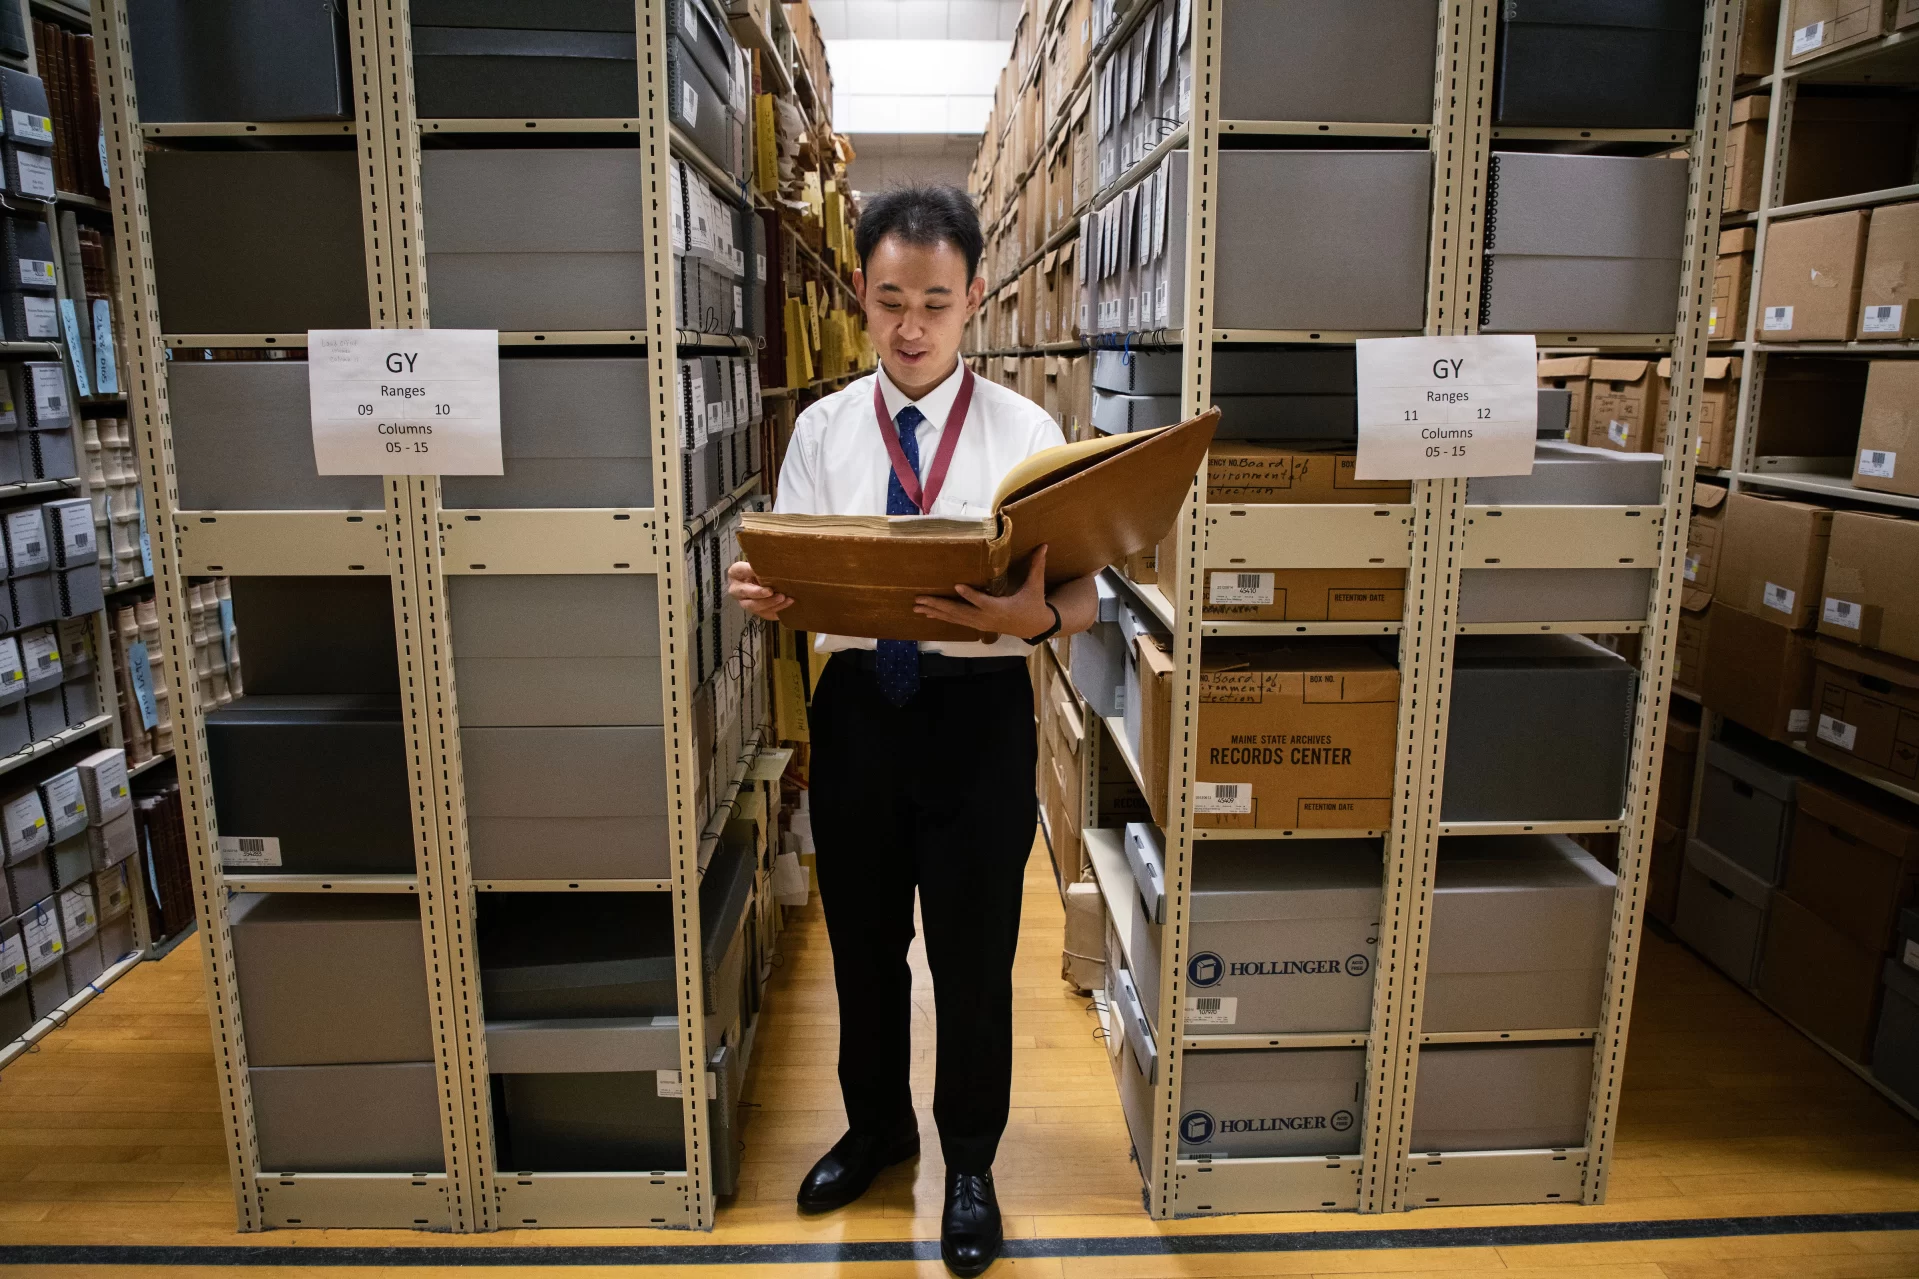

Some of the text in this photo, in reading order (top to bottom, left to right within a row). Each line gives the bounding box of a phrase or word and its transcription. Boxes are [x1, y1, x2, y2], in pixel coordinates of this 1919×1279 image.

[386, 352, 418, 373] GY
[1433, 359, 1464, 378] GY
[381, 386, 425, 398] Ranges
[1427, 391, 1469, 404] Ranges
[358, 404, 450, 416] 09 10
[1404, 409, 1491, 421] 11 12
[378, 423, 432, 435] Columns
[1421, 428, 1473, 439] Columns
[386, 442, 402, 453] 05
[414, 442, 428, 453] 15
[1425, 446, 1440, 457] 05
[1452, 446, 1466, 456] 15
[1239, 458, 1284, 468] Board
[1212, 672, 1255, 683] Board
[1231, 735, 1331, 744] MAINE STATE ARCHIVES
[1210, 748, 1352, 764] RECORDS CENTER
[1230, 960, 1340, 976] HOLLINGER
[1220, 1116, 1327, 1133] HOLLINGER
